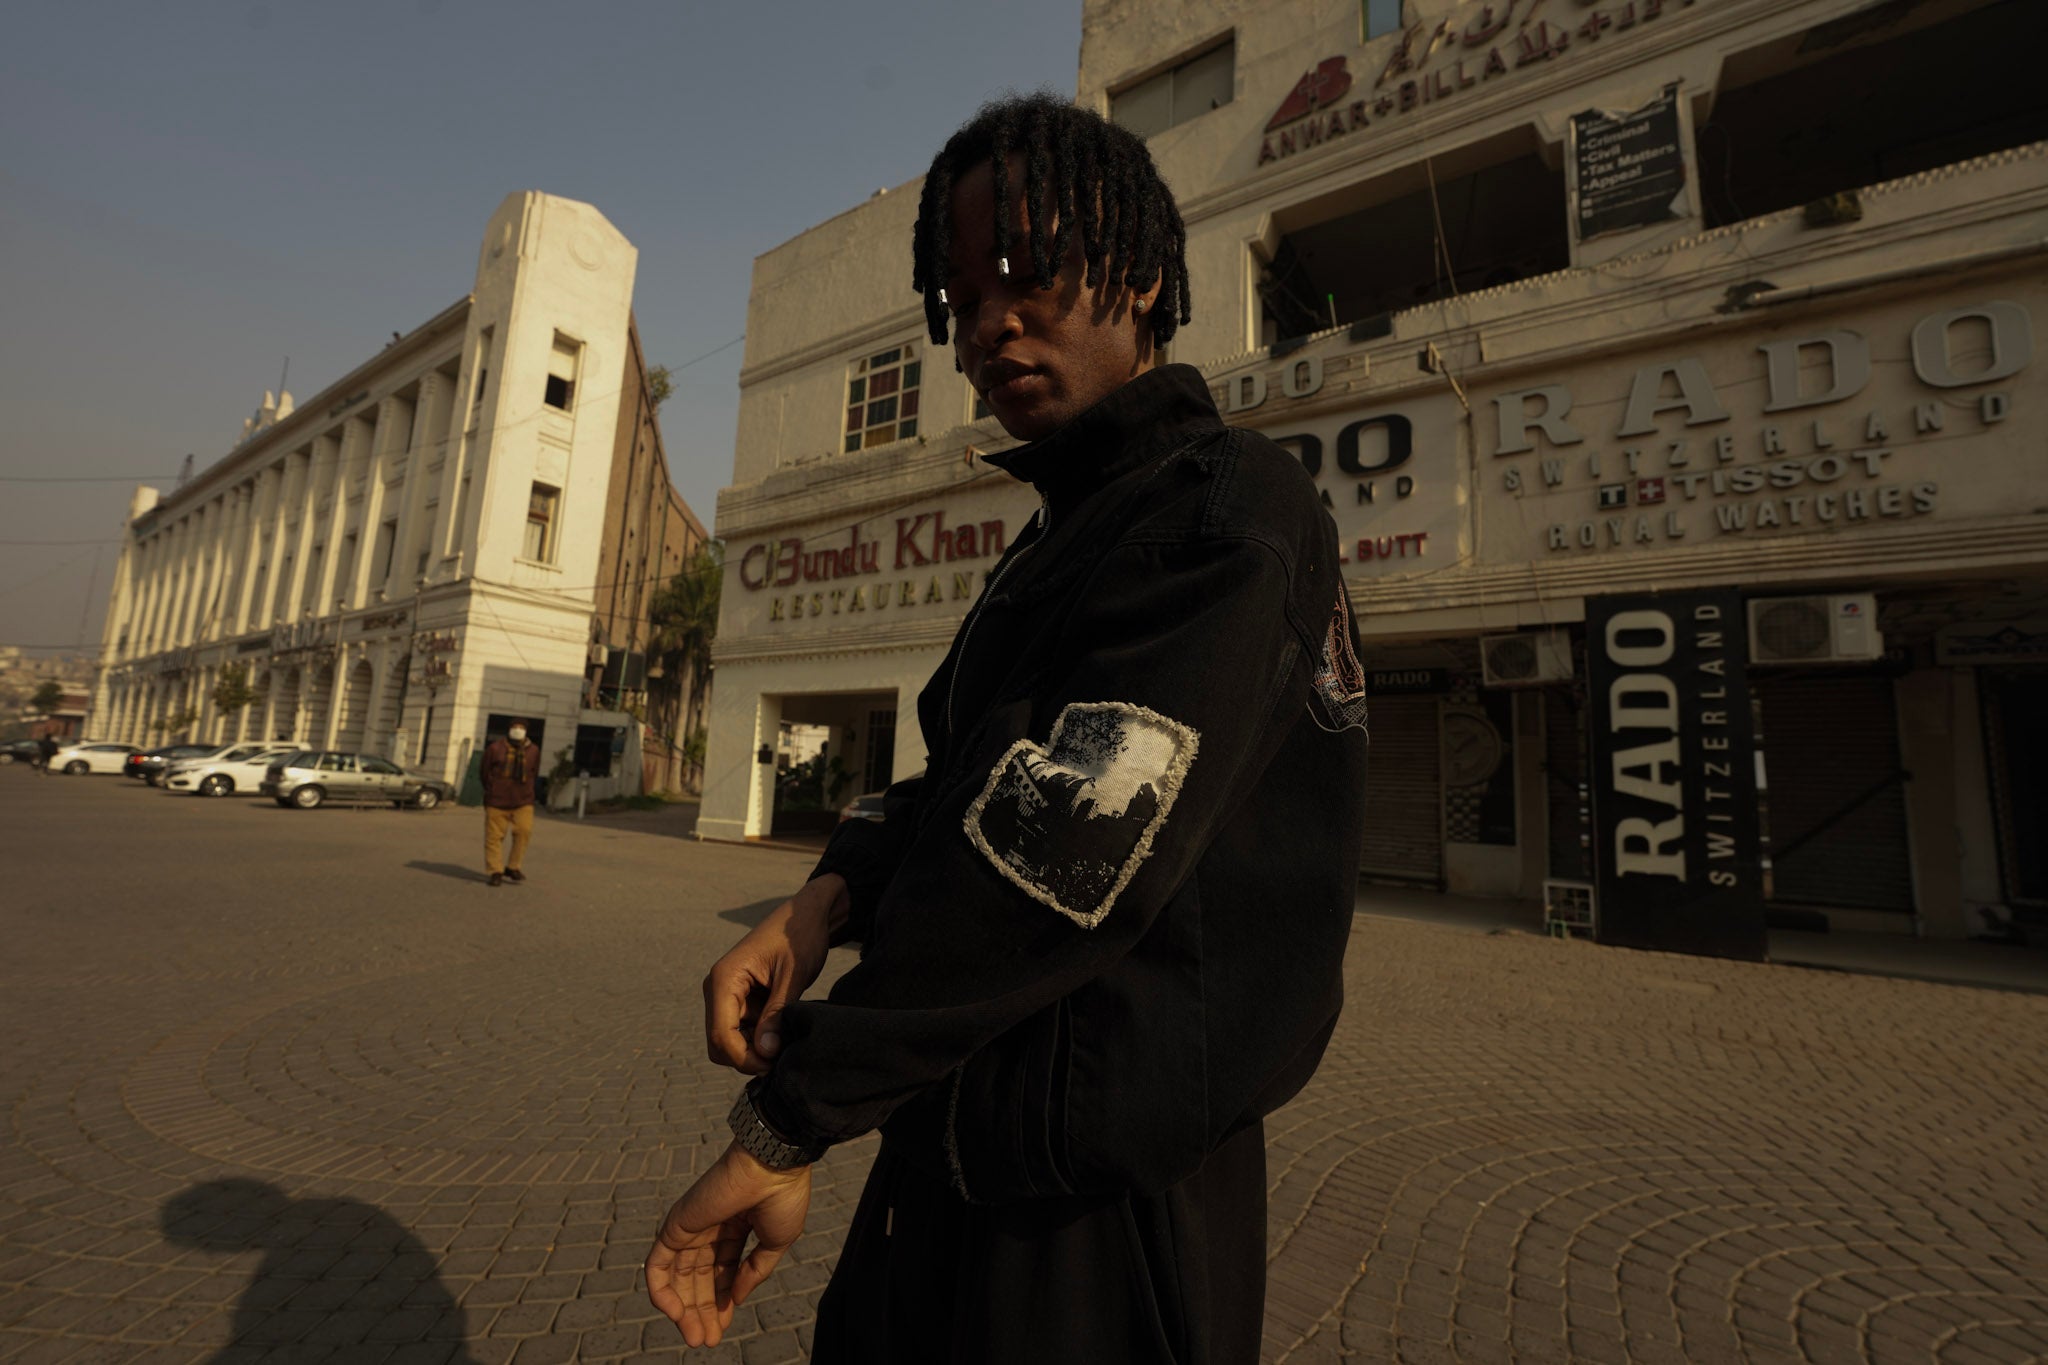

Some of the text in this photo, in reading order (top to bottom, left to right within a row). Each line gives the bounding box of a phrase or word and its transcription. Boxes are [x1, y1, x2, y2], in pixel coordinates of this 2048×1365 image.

[1586, 121, 1650, 150] Criminal
[1587, 144, 1622, 163] Civil
[1588, 143, 1676, 177] Tax Matters
[1588, 164, 1643, 192] Appeal
[1491, 302, 2034, 458] RADO
[1505, 392, 2009, 491] SWITZERLAND
[1673, 447, 1891, 499] TISSOT
[1549, 482, 1938, 551] ROYAL WATCHES
[770, 511, 1006, 588] Bundu Khan
[1358, 532, 1426, 562] BUTT
[769, 570, 993, 622] RESTAURAN
[1373, 670, 1432, 687] RADO
[1604, 603, 1737, 888] RADO SWITZERLAND
